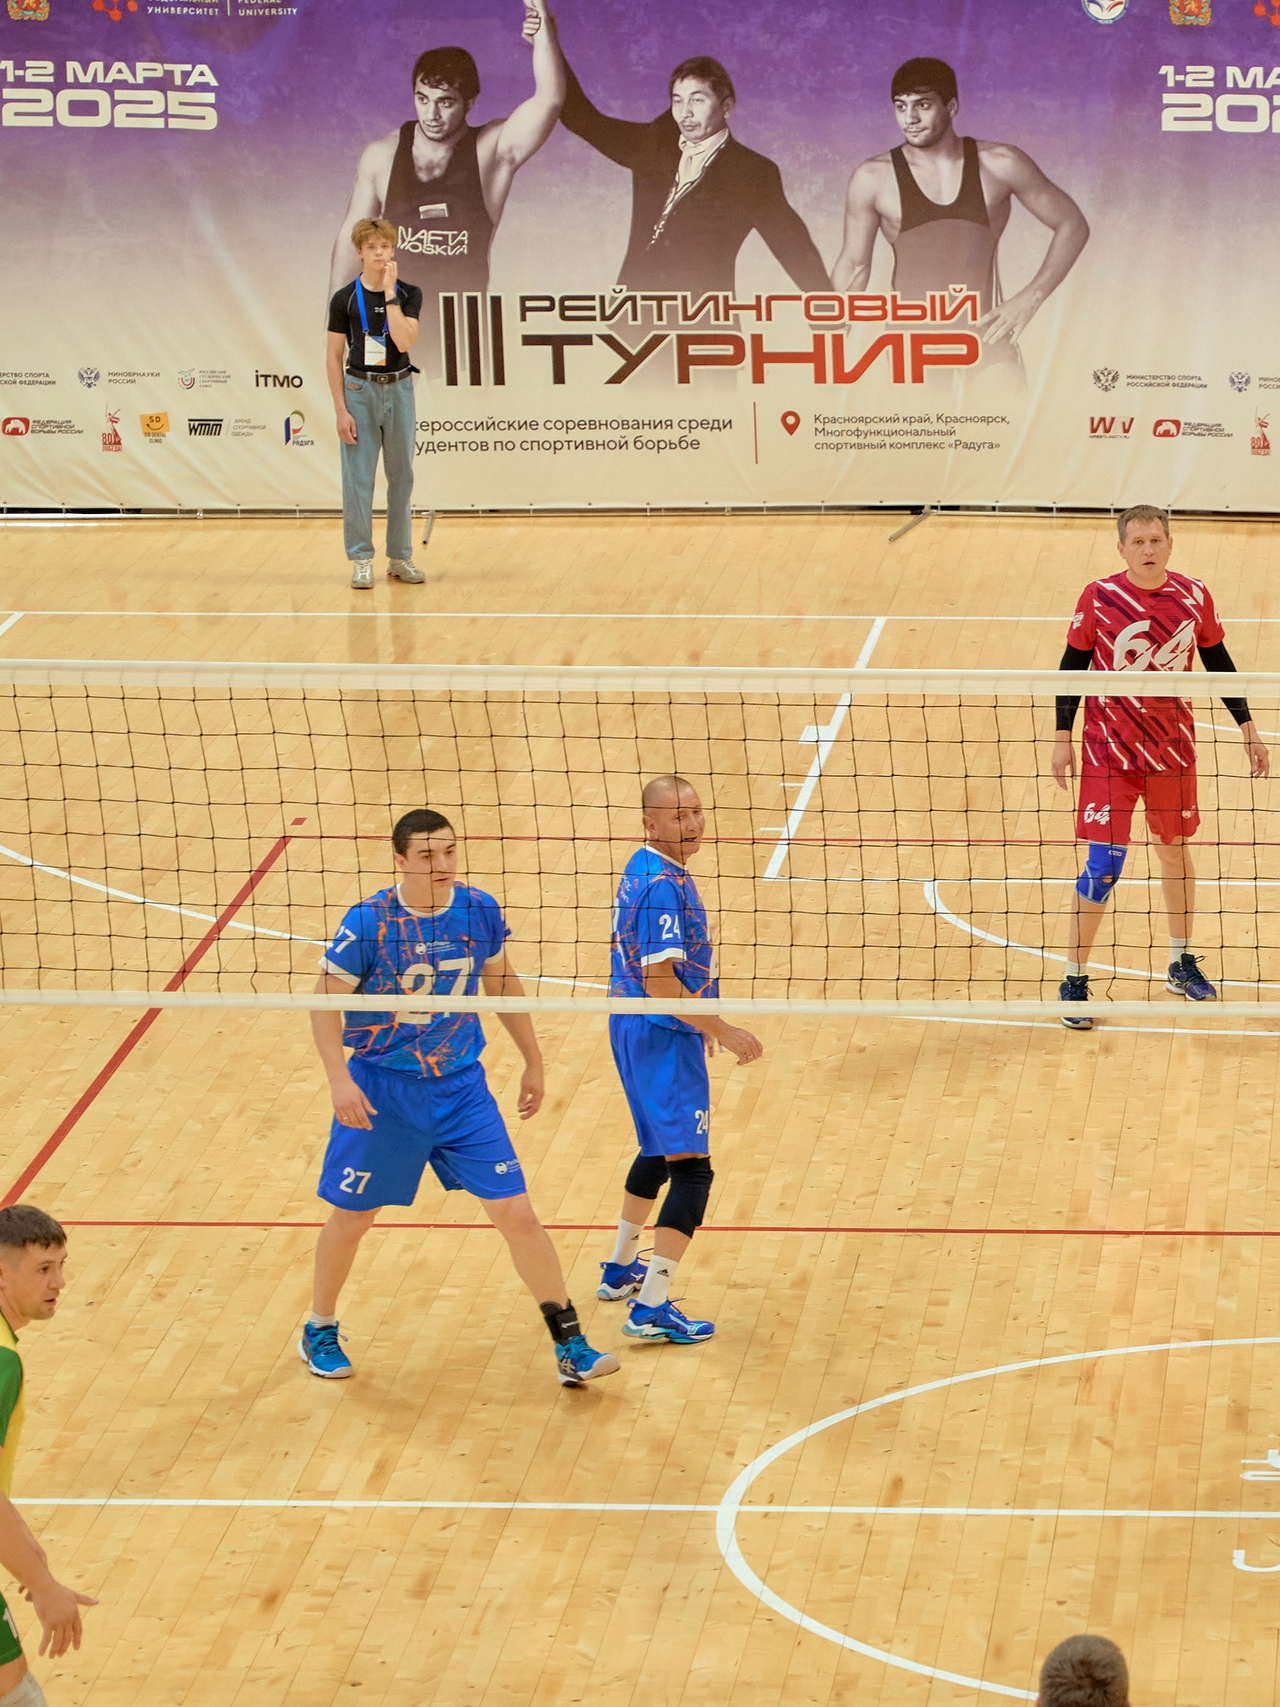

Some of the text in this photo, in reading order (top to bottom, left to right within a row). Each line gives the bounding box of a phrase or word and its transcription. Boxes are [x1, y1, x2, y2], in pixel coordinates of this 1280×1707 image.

[147, 6, 219, 15] УНИВЕРСИТЕТ
[238, 8, 298, 16] UNIVERSITY
[0, 60, 219, 86] 1-2 МАРТА
[1158, 65, 1214, 87] 1-2
[1, 88, 218, 130] 2025
[397, 225, 468, 247] NAFTA
[519, 284, 981, 325] РЕЙТИНГОВЫЙ
[520, 331, 981, 386] ТУРНИР
[416, 416, 733, 435] ероссийские соревнования среди
[814, 413, 1010, 425] Красноярский край, Красноярск,
[814, 426, 957, 439] Многофункциональный
[415, 435, 701, 456] удентов по спортивной борьбе
[814, 439, 1001, 452] спортивный комплекс «Радуга»
[1113, 619, 1196, 671] 64
[1084, 802, 1112, 825] 64
[658, 914, 681, 941] 24
[395, 956, 475, 1025] 27
[339, 1167, 372, 1195] 27
